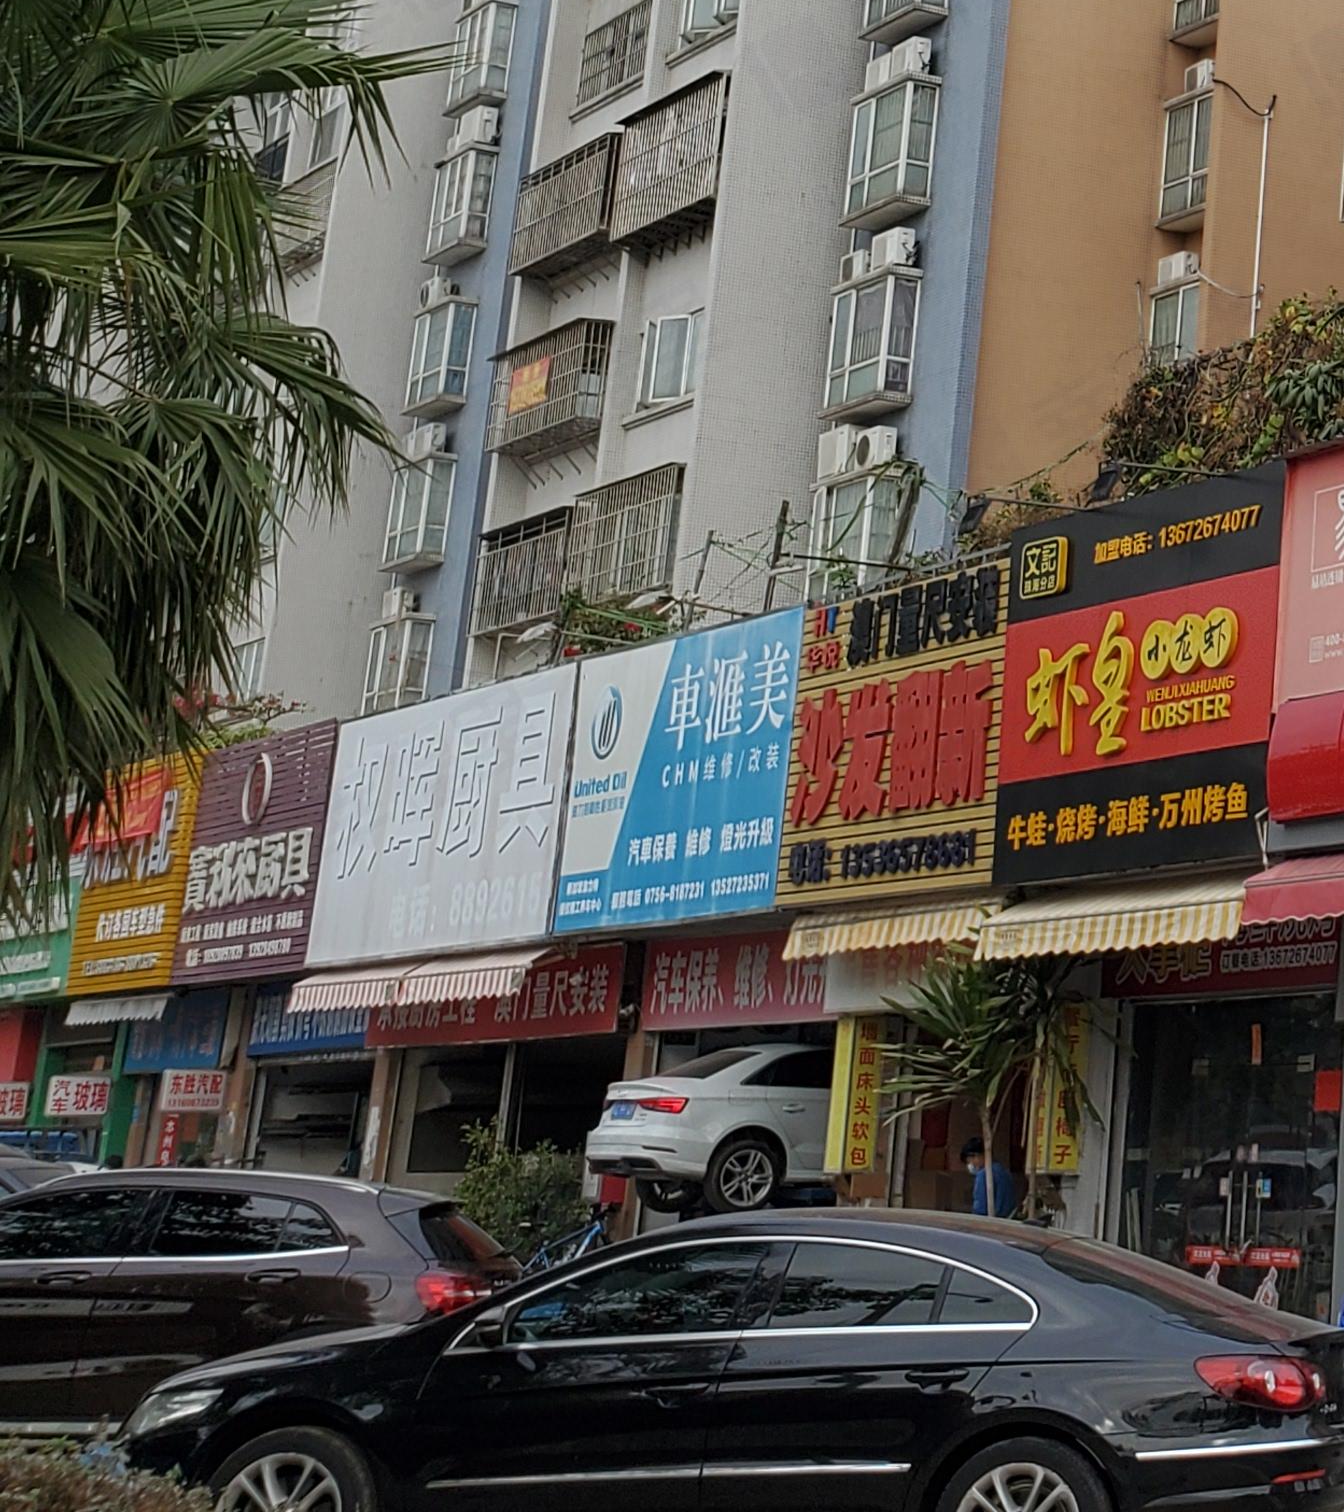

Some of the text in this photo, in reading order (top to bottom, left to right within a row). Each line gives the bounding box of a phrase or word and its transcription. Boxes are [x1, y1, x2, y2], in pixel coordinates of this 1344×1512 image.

[1146, 616, 1228, 665] 小龙虾
[1141, 693, 1232, 732] LOBSTER
[790, 658, 993, 828] 沙发翻新
[573, 775, 610, 800] United
[73, 1081, 108, 1114] 玻璃
